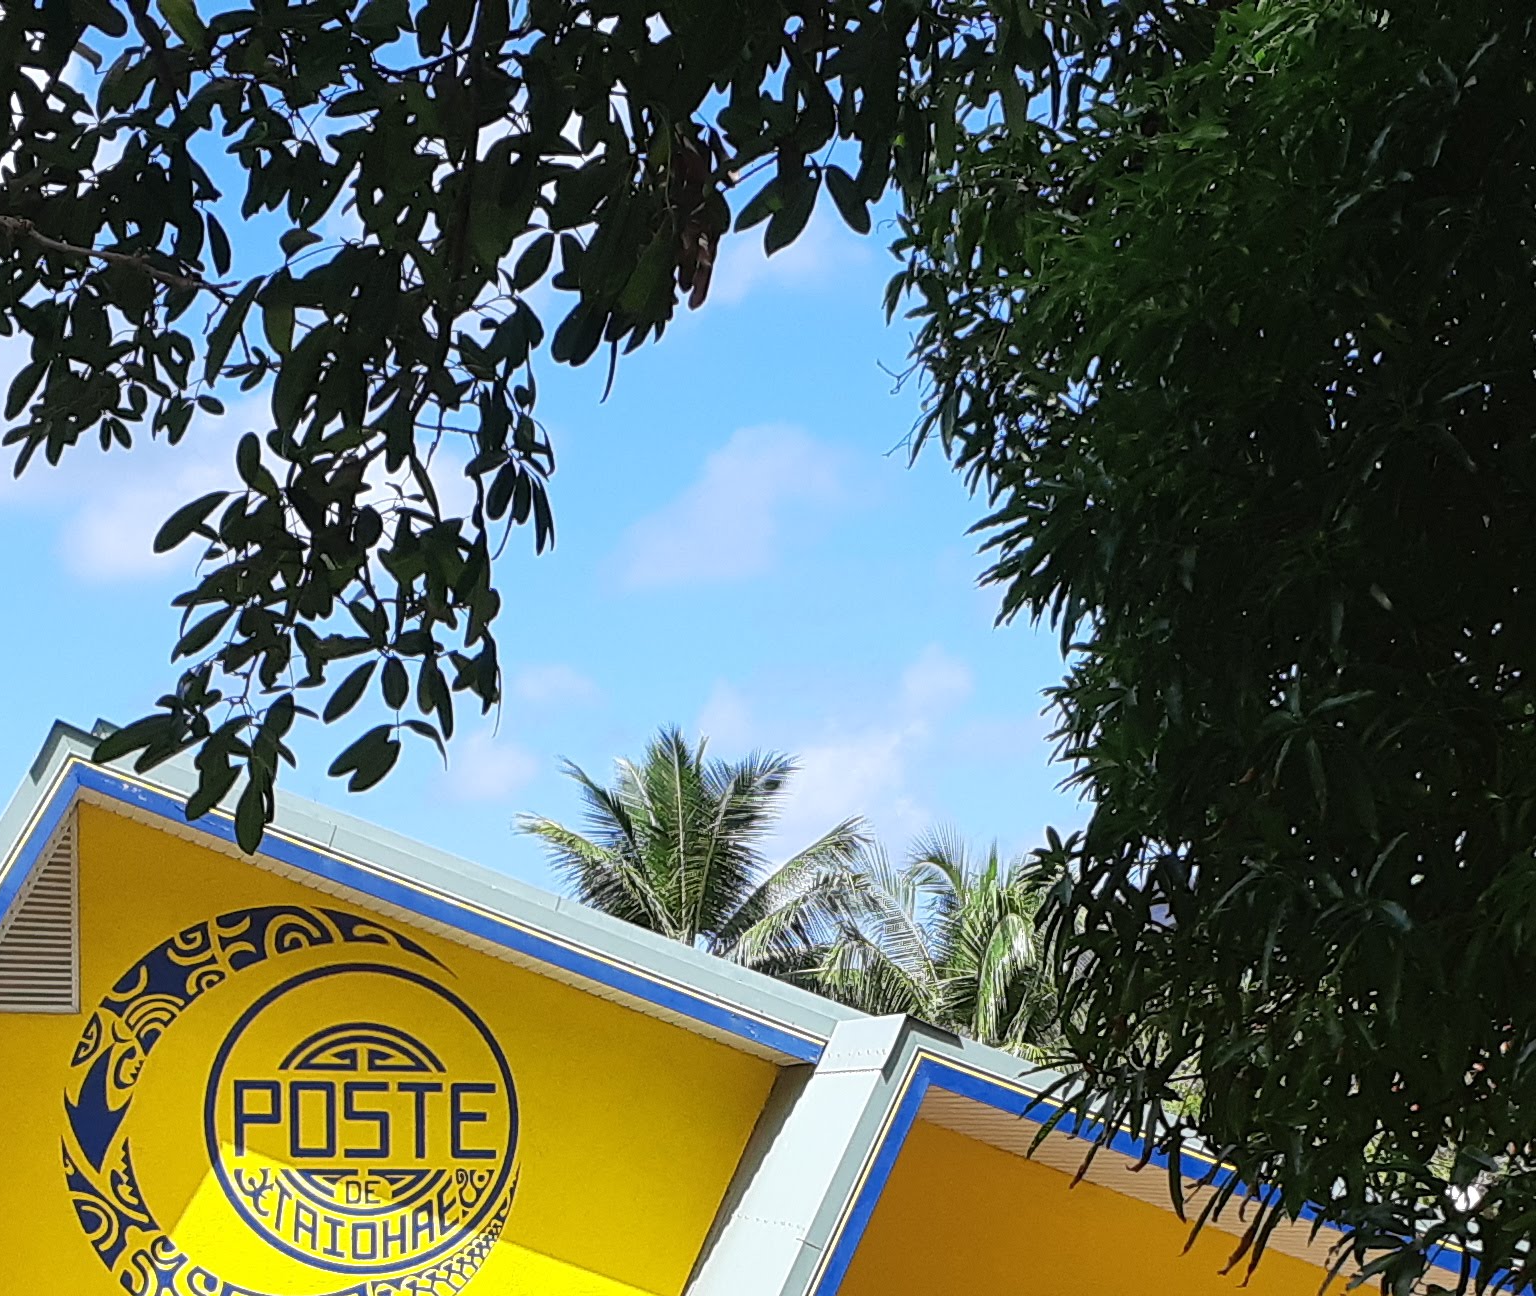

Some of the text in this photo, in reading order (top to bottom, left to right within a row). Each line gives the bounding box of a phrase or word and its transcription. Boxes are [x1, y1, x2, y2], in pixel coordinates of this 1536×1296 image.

[233, 1079, 497, 1160] POSTE
[274, 1176, 460, 1260] TAIOHAE
[345, 1180, 382, 1204] DE
